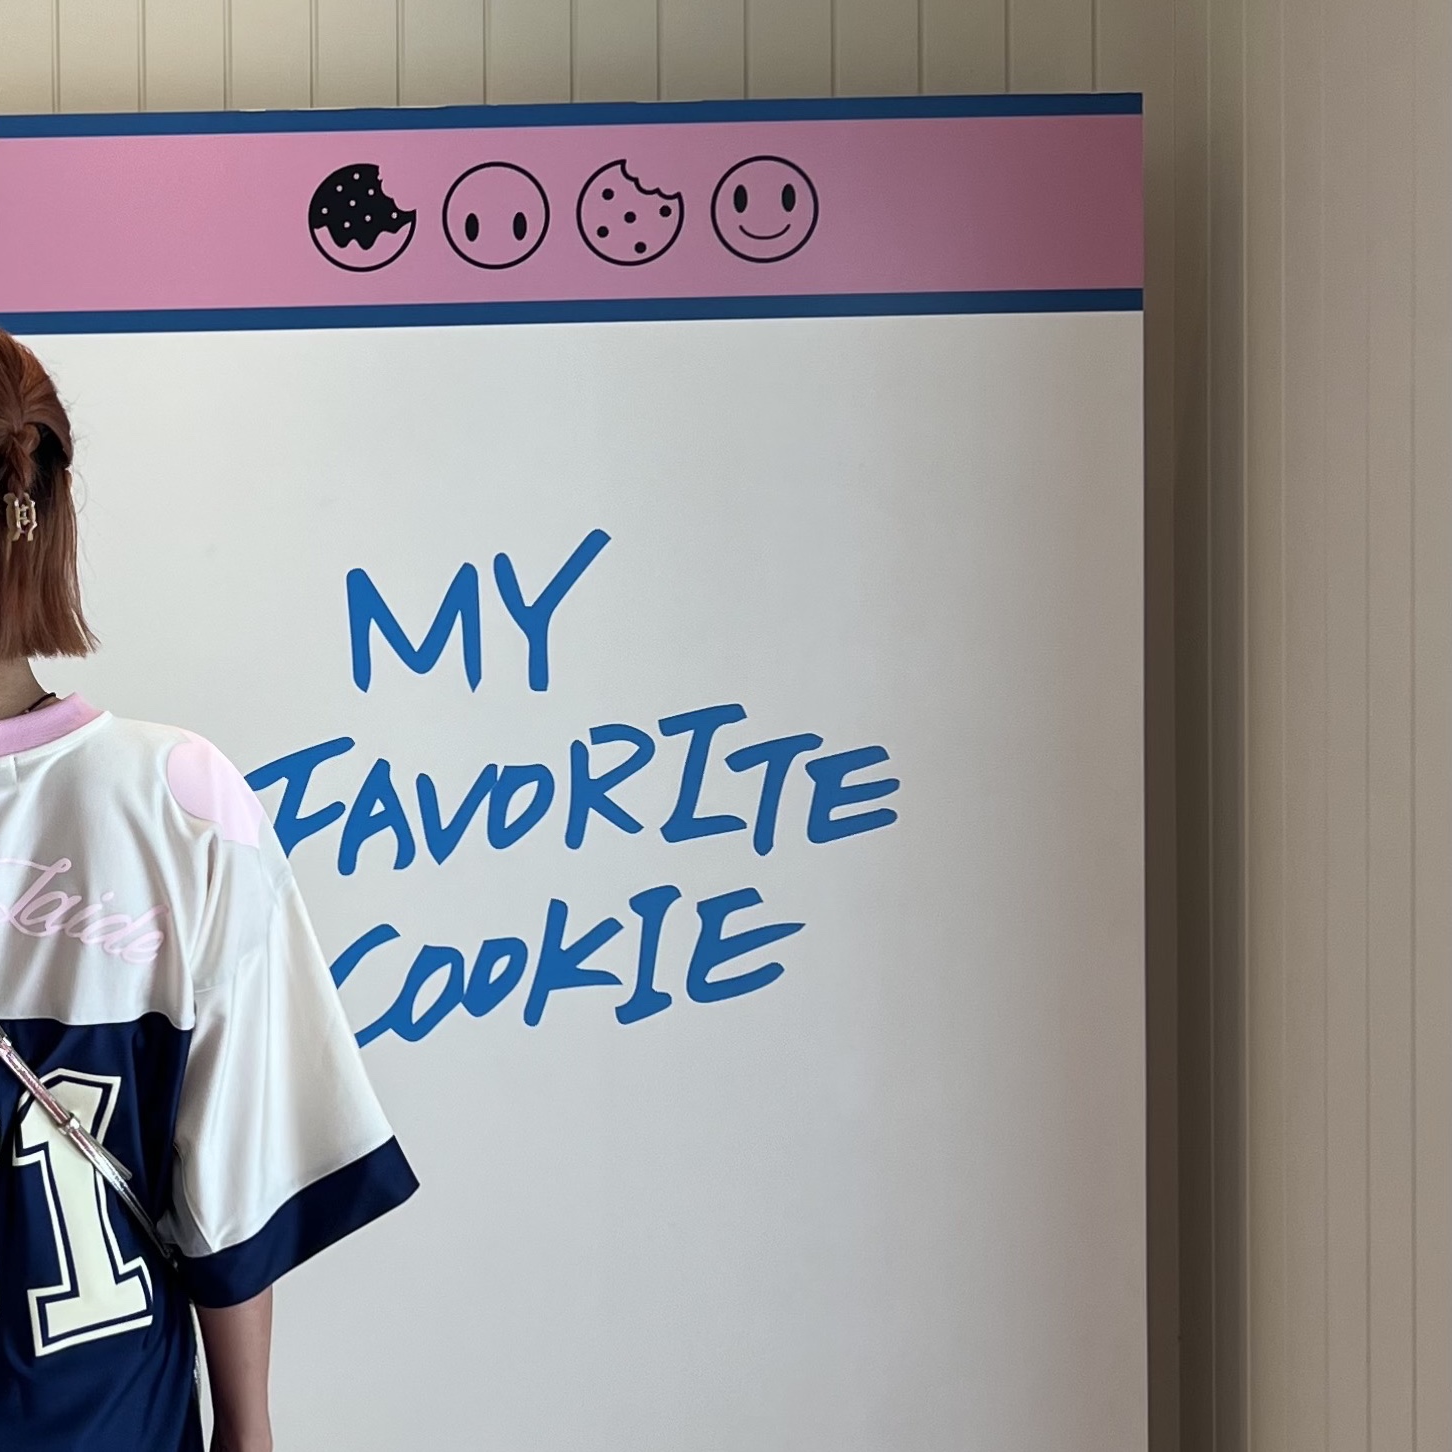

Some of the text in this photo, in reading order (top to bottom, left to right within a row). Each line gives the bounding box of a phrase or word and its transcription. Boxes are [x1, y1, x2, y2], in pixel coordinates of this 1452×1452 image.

[346, 528, 611, 693] MY
[244, 703, 900, 875] FAVORITE
[329, 885, 806, 1048] COOKIE
